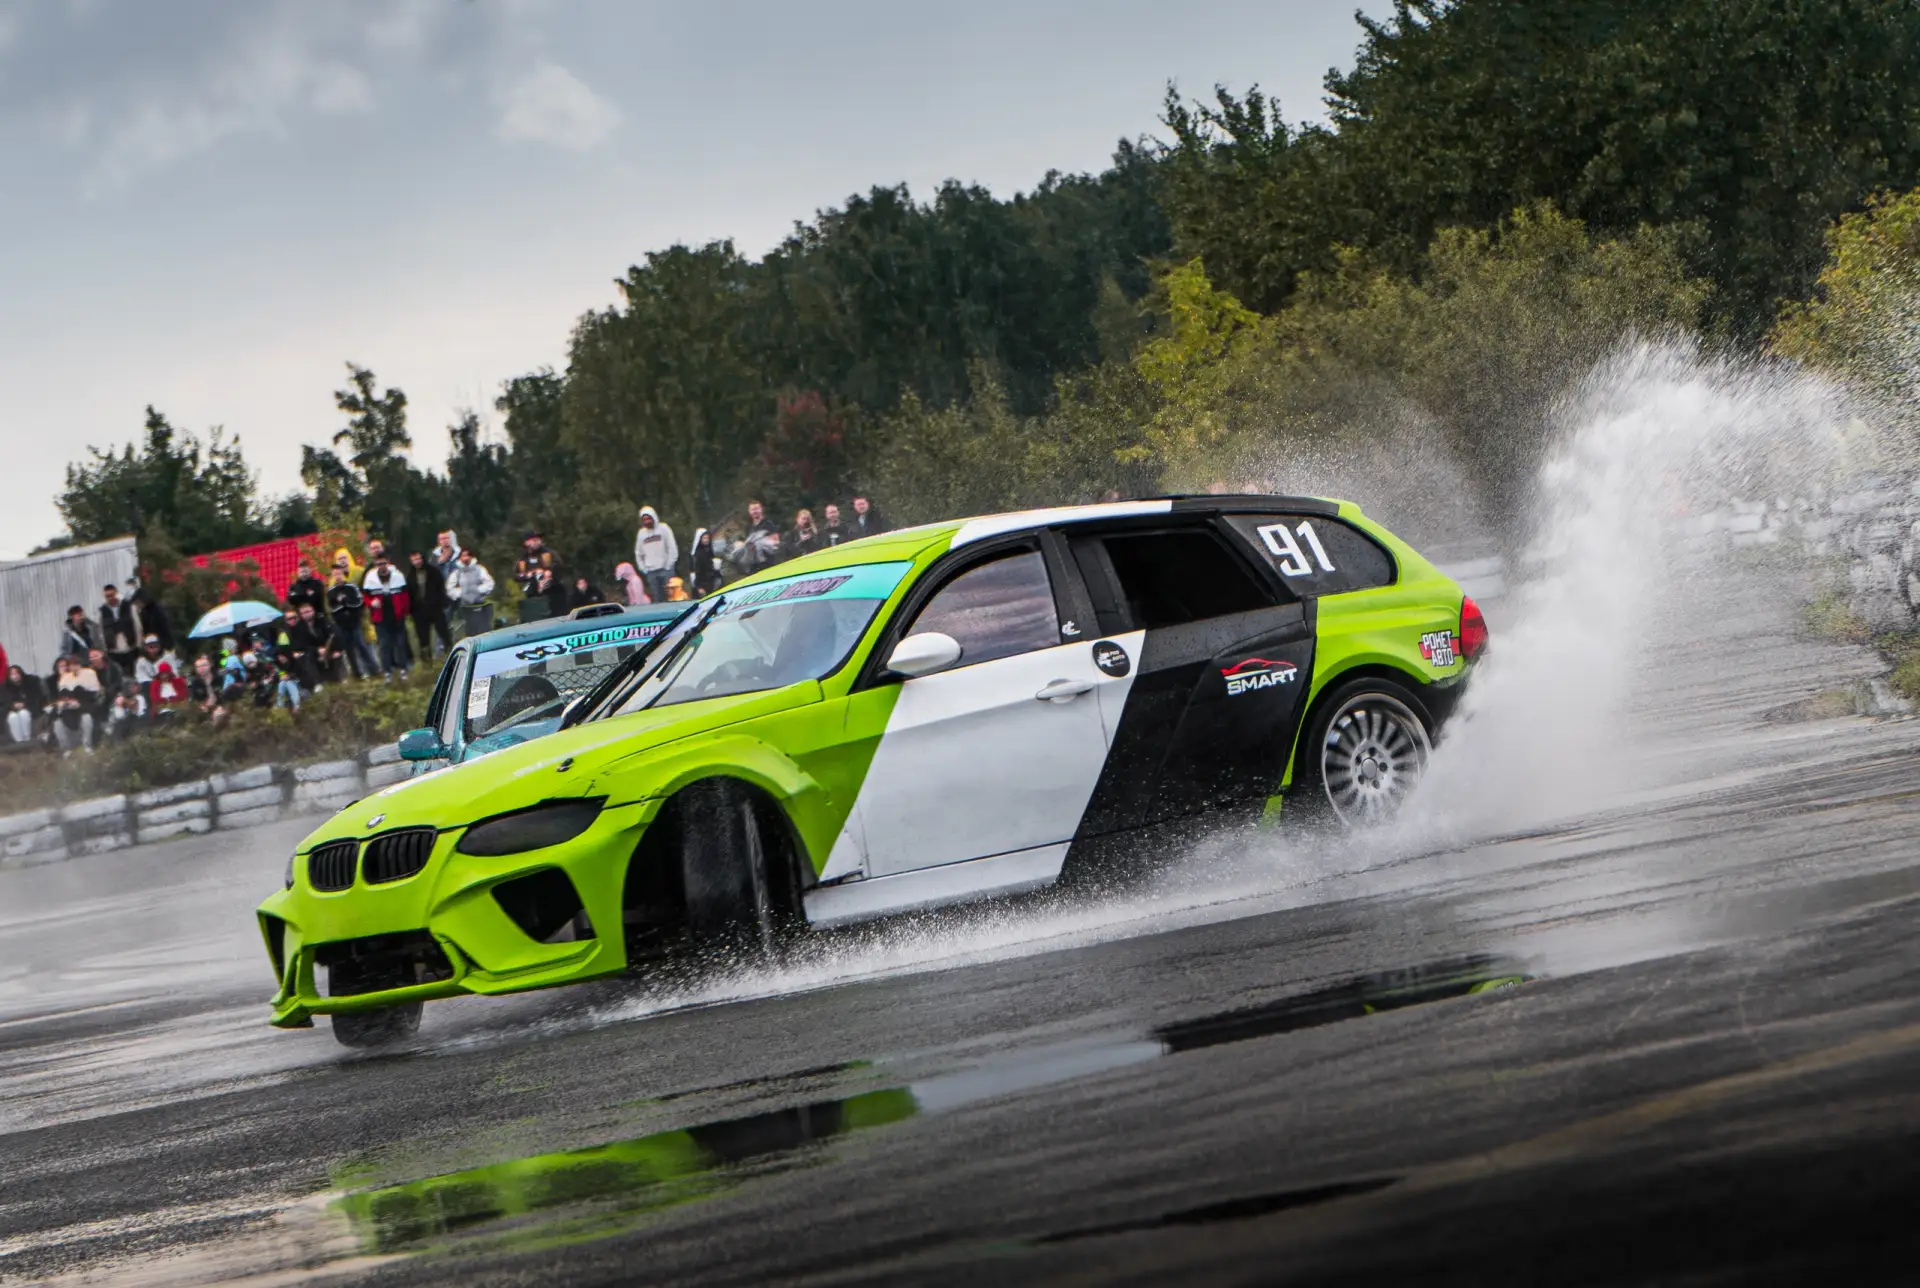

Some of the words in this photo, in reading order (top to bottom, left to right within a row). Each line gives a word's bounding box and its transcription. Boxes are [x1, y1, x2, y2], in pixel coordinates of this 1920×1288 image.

[1257, 520, 1336, 576] 91
[567, 632, 598, 648] ЧТО
[601, 629, 625, 642] ПО
[626, 624, 666, 639] ДРИ
[1431, 647, 1454, 667] АВТО
[1227, 667, 1297, 696] SMART
